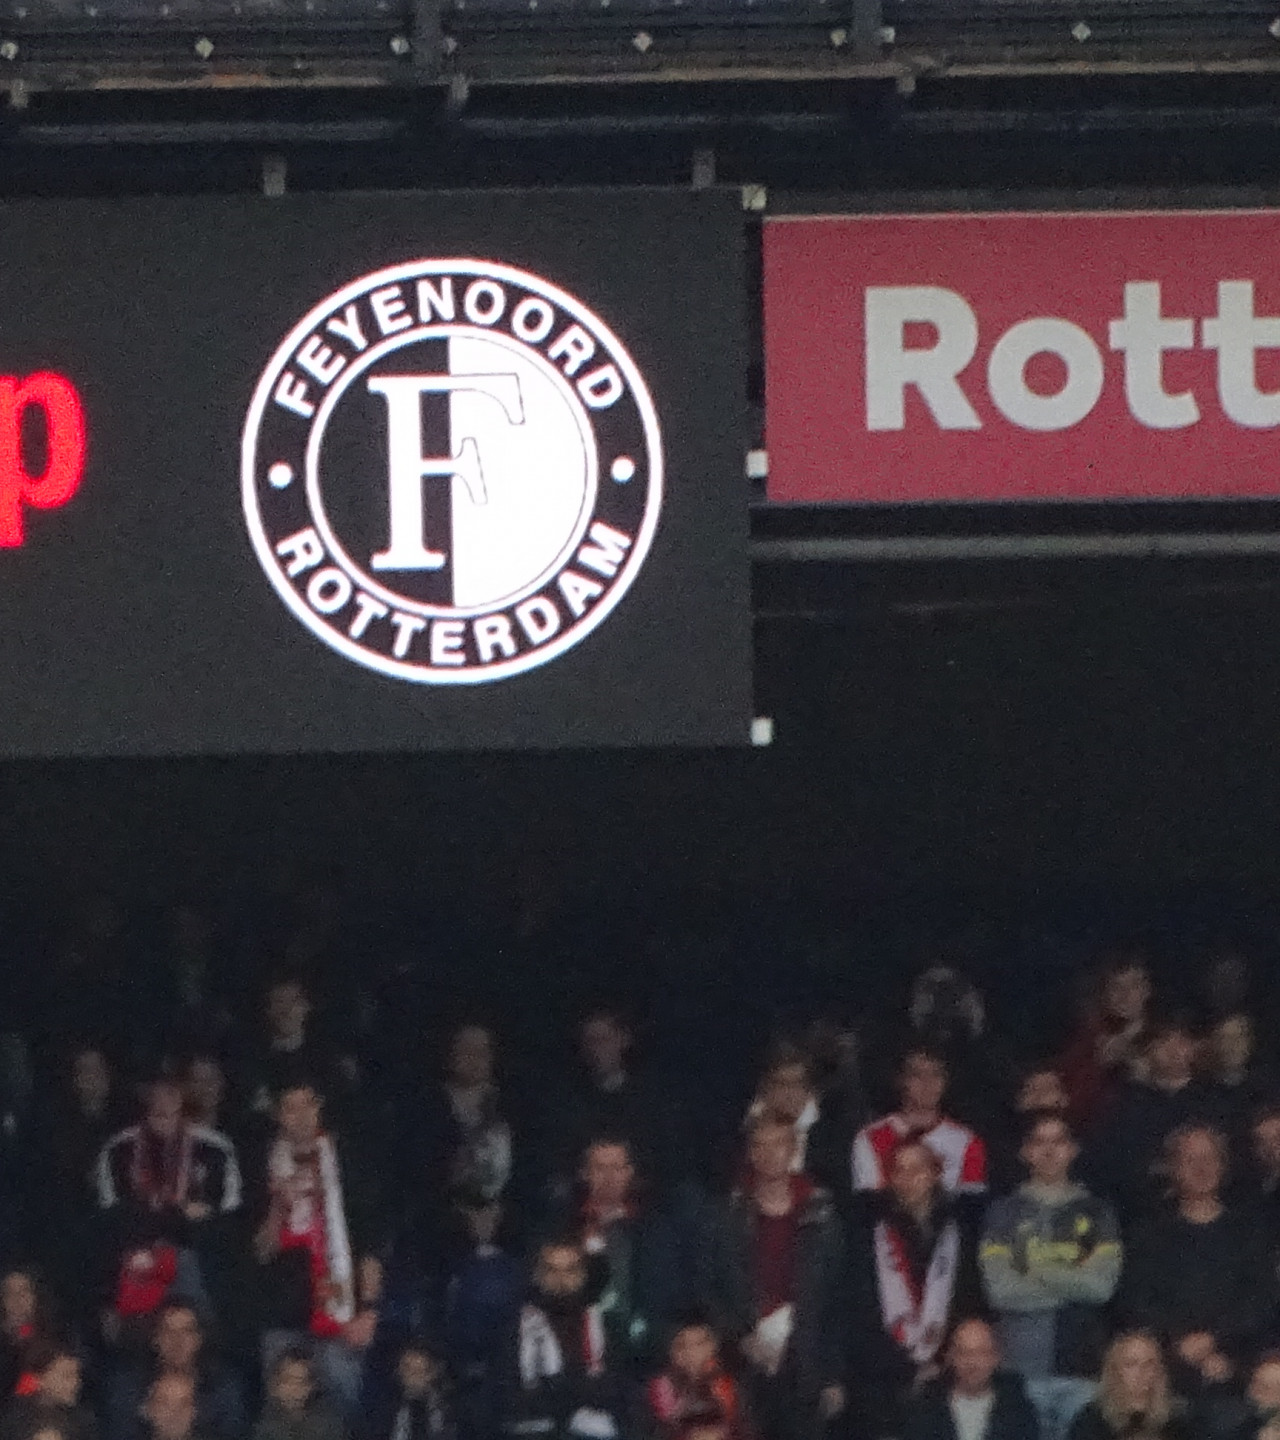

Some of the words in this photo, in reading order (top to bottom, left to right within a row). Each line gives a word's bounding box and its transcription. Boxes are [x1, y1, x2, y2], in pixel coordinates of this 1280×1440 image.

[273, 276, 625, 419] FEYENOORD
[864, 279, 1280, 432] Rott
[275, 520, 633, 666] ROTTERDAM
